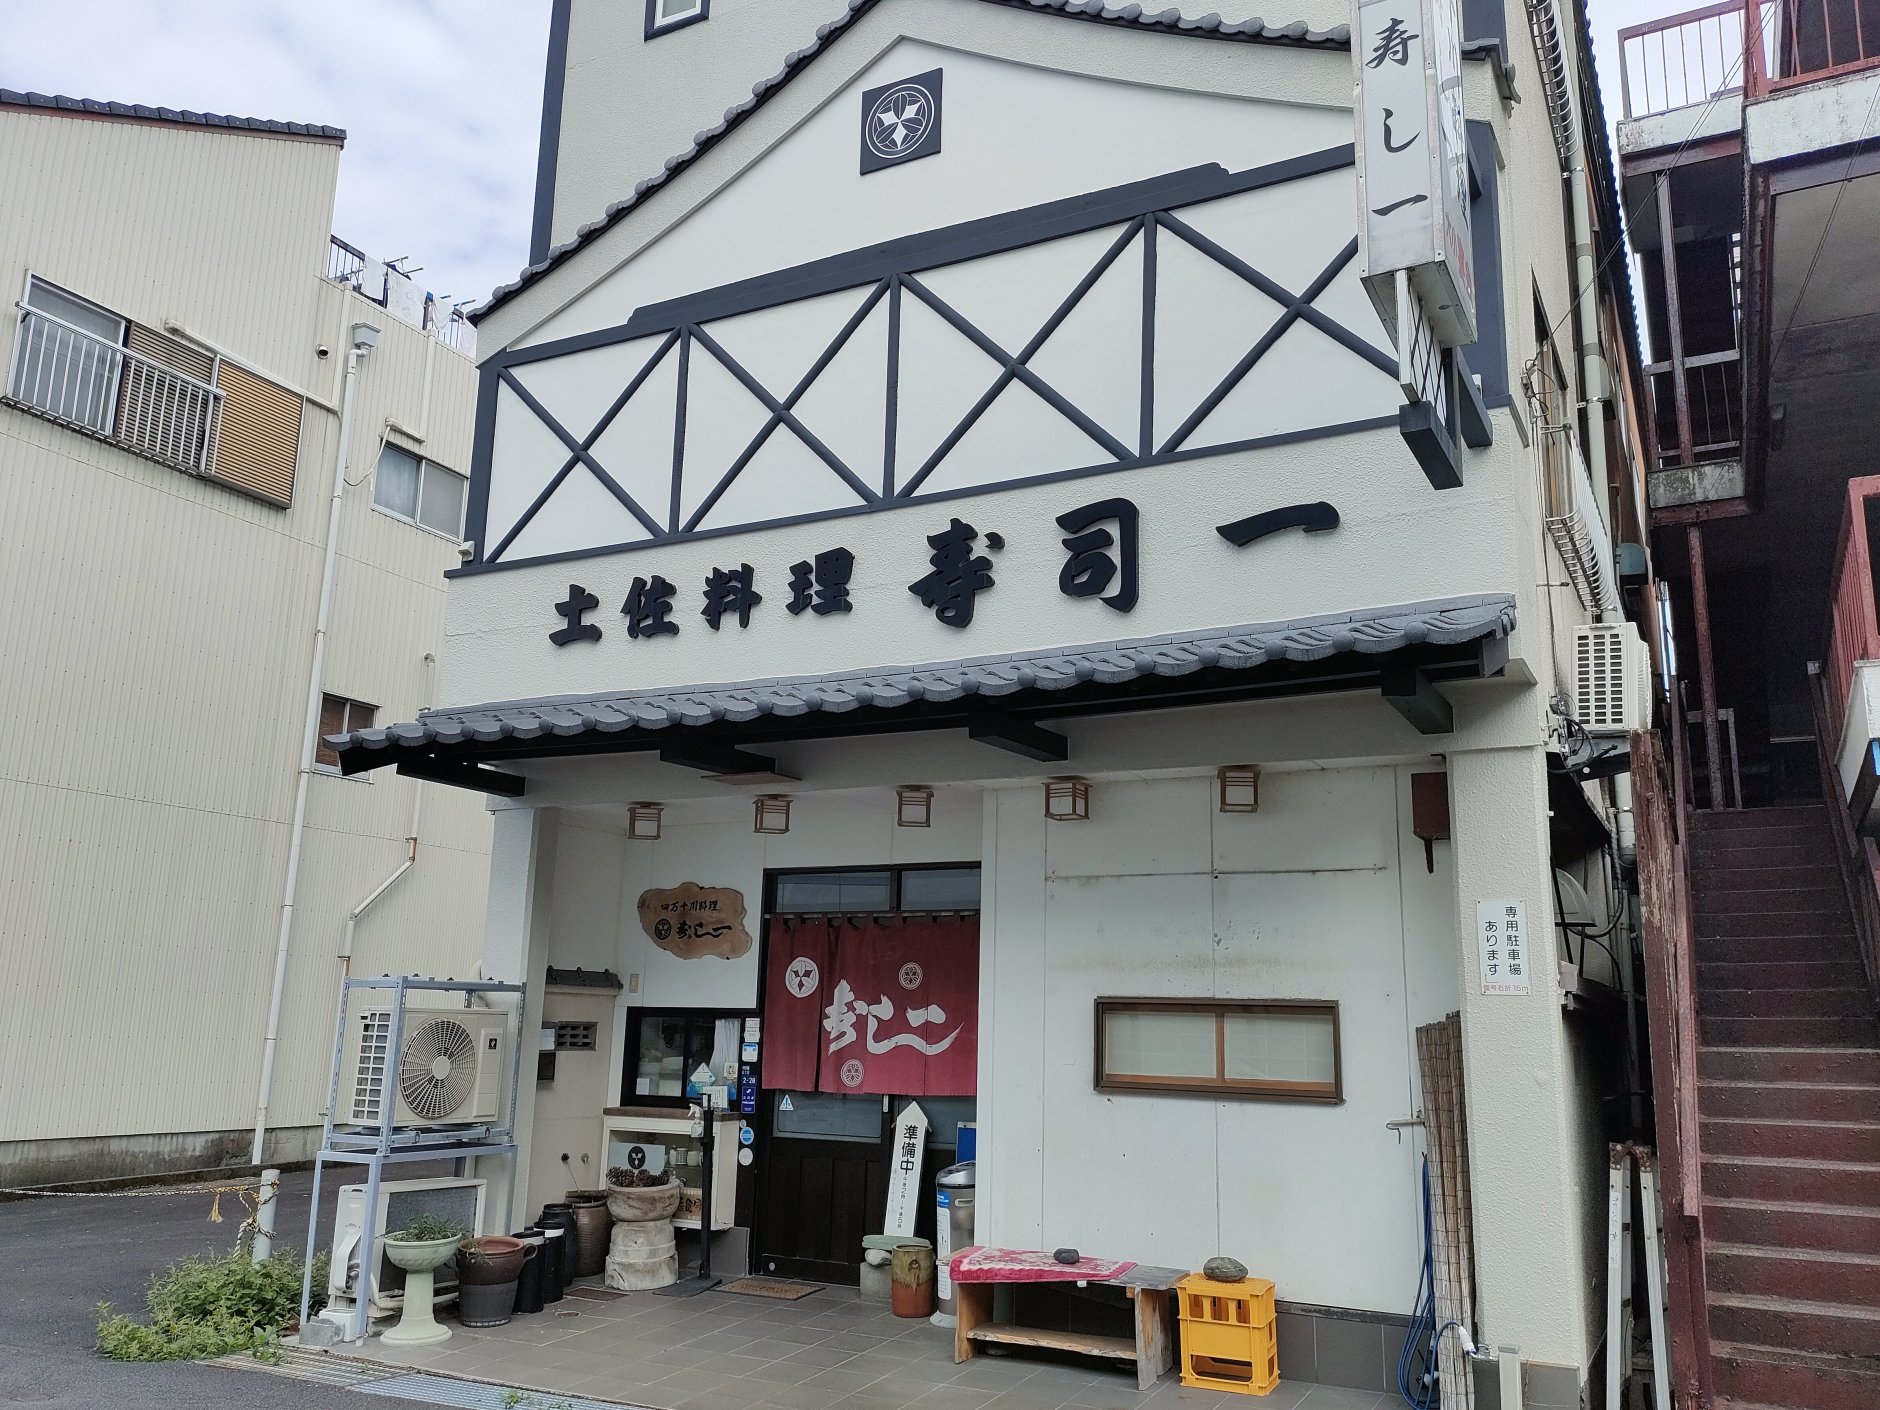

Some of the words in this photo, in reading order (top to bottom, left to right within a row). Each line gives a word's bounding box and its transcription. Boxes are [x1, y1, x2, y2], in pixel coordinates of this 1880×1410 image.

[1365, 17, 1428, 217] 寿し一
[548, 546, 855, 647] 土佐料理
[908, 497, 1341, 629] 寿司一
[660, 899, 719, 913] 四万十川料理
[1484, 920, 1500, 976] あります
[1504, 905, 1522, 976] 専用駐車場
[742, 1076, 756, 1084] 2-28
[900, 1124, 919, 1176] 準備中
